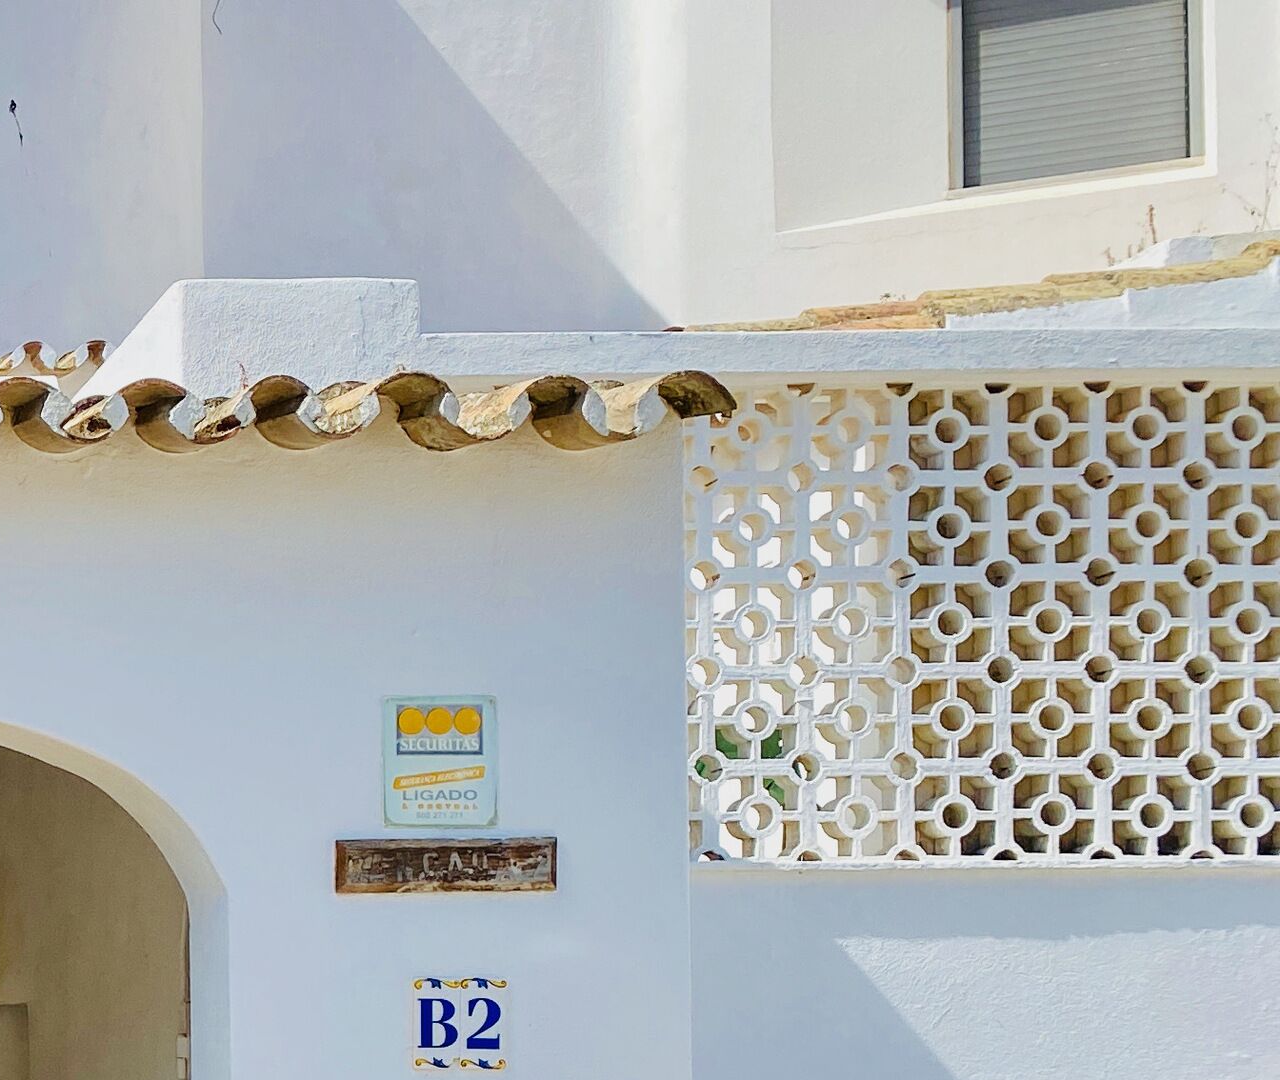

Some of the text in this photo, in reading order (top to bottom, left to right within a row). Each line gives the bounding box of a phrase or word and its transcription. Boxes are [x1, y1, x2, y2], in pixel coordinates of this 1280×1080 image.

[399, 737, 480, 752] SECURITAS
[402, 789, 478, 801] LIGADO
[417, 997, 502, 1050] B2
